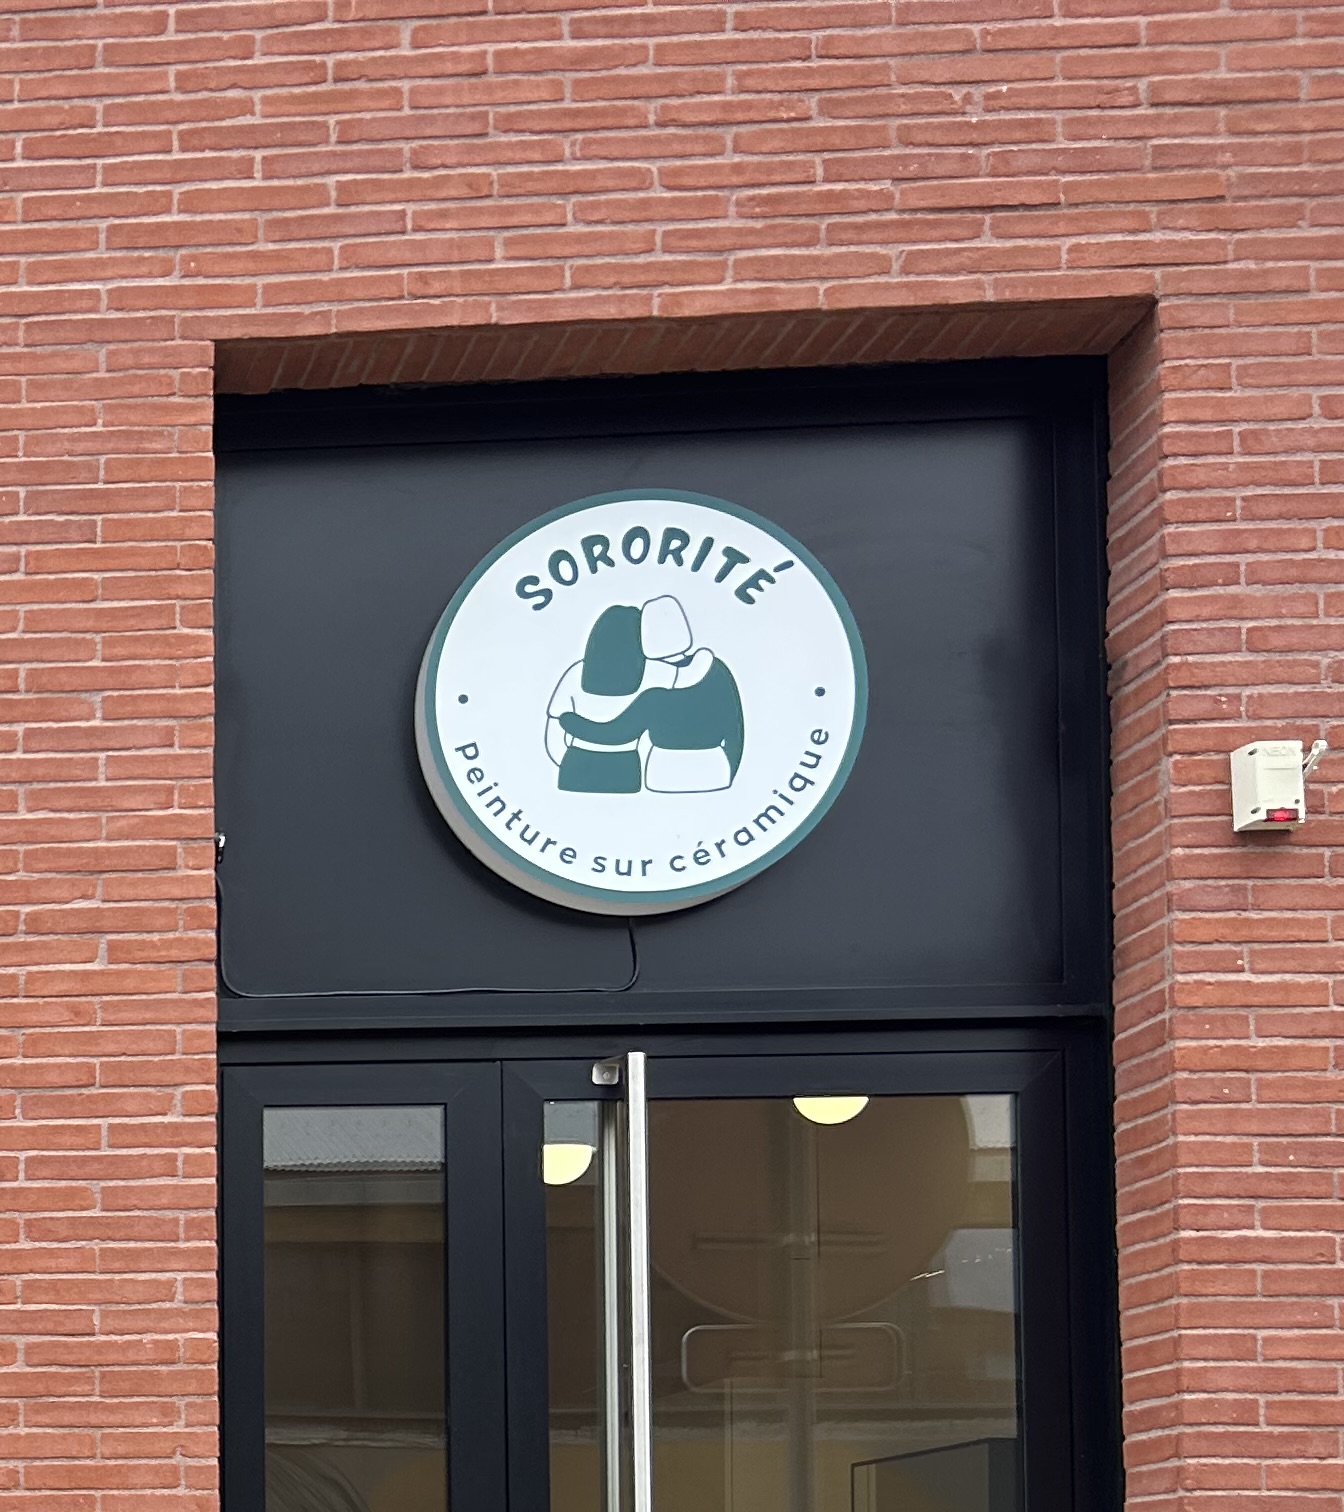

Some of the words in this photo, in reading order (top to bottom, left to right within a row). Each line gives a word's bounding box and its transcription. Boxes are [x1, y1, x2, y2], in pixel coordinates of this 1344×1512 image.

[514, 525, 795, 612] SORORITÉ
[454, 740, 578, 867] Peinture
[590, 854, 653, 878] sur
[668, 726, 830, 874] céramique
